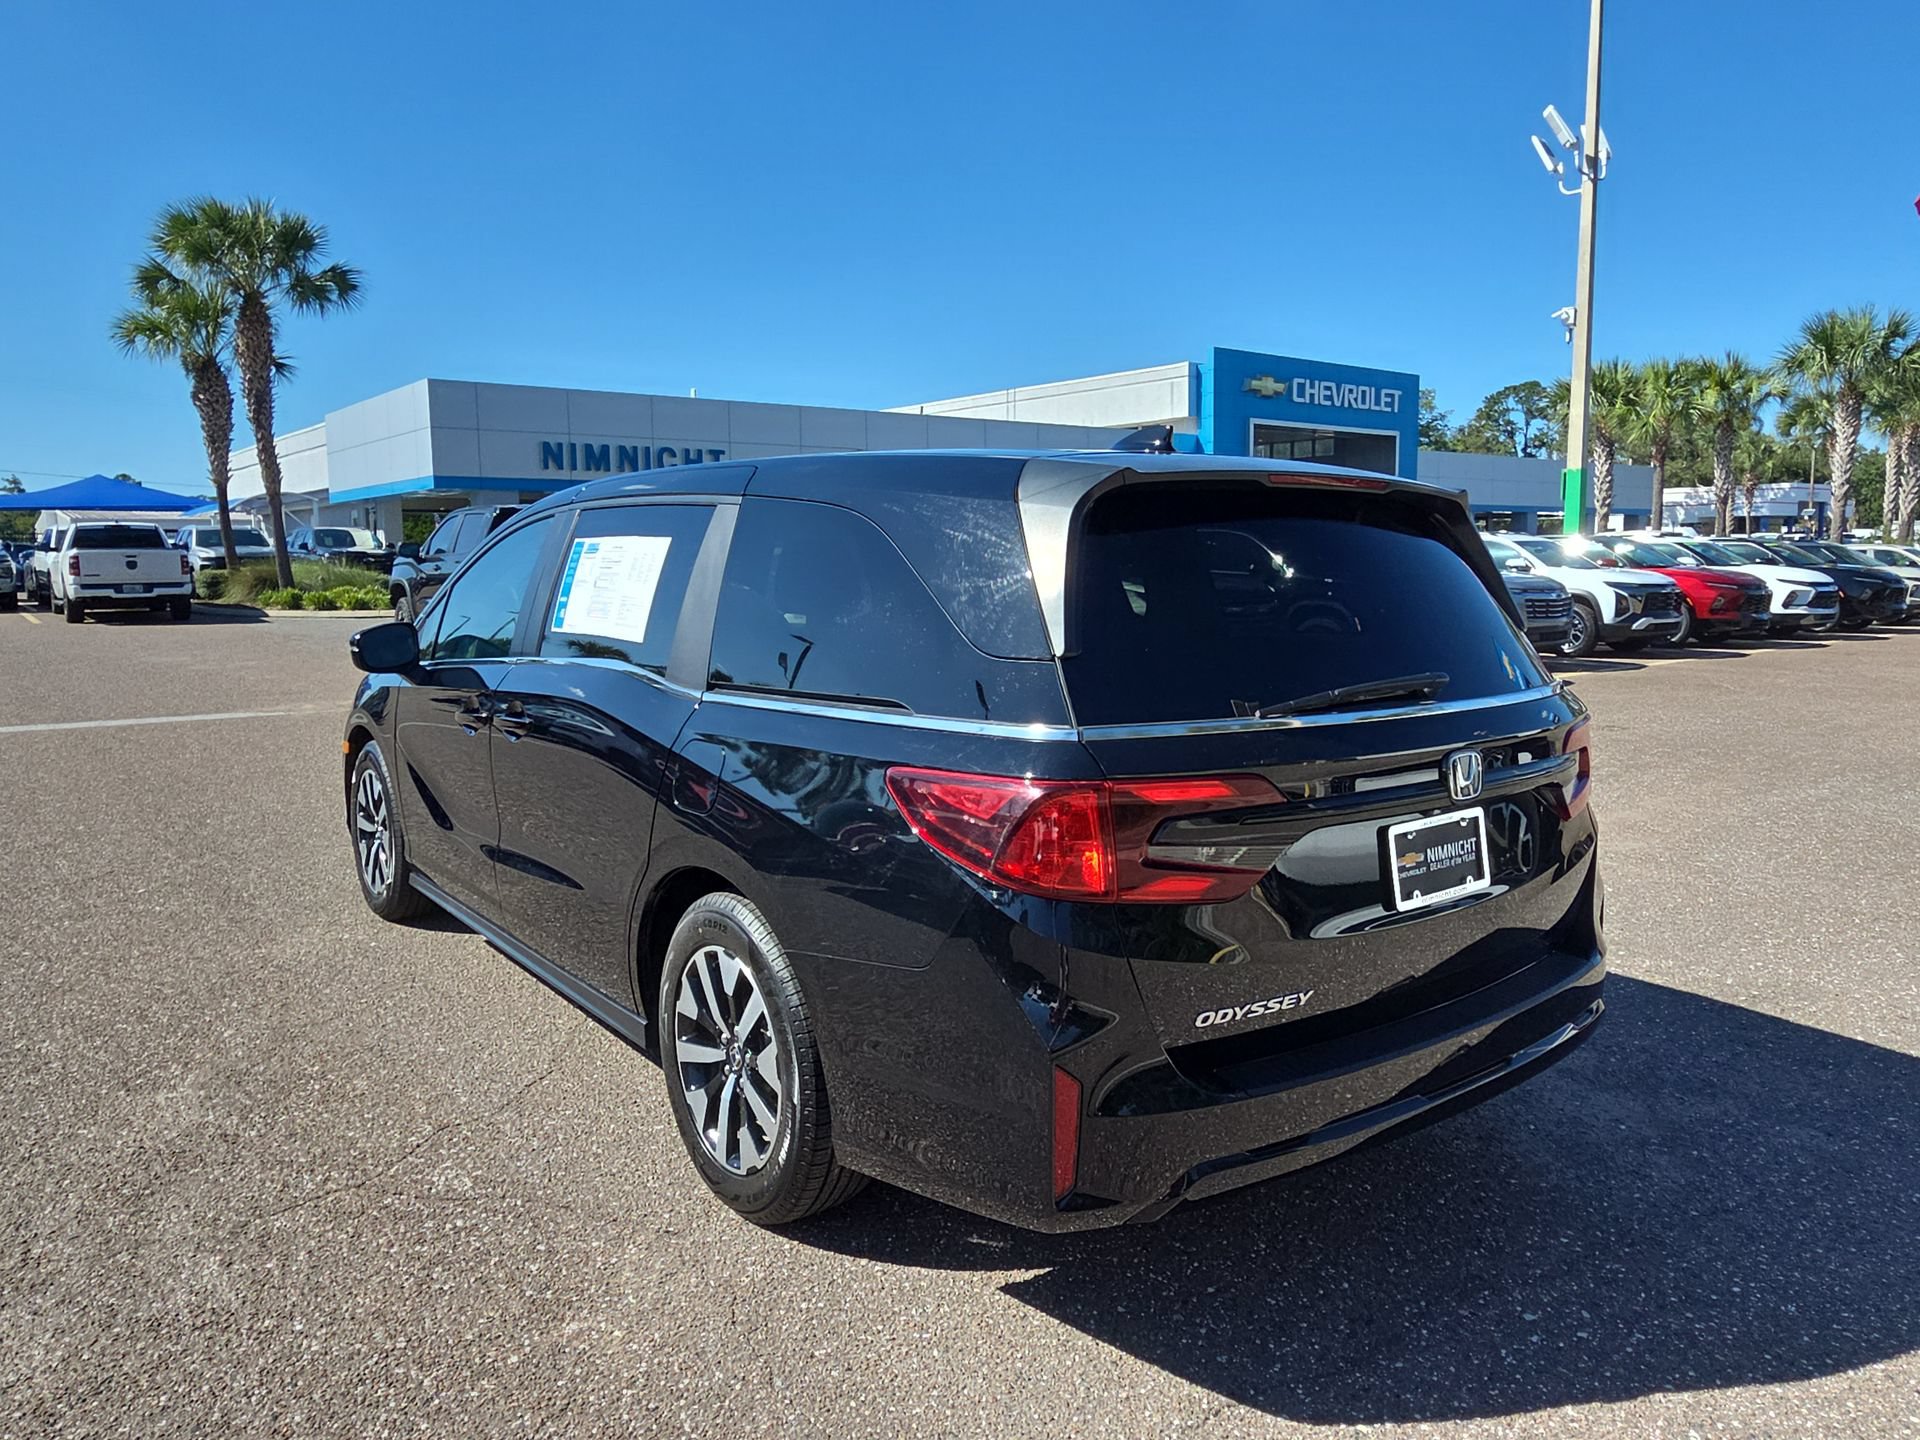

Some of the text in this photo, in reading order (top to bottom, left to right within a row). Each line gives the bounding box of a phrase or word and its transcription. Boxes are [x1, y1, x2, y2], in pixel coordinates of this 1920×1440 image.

[1292, 377, 1403, 414] CHEVROLET
[541, 441, 726, 473] NIMNICHT
[1426, 837, 1477, 863] NIMNICHT
[1194, 989, 1315, 1028] ODYSSEY
